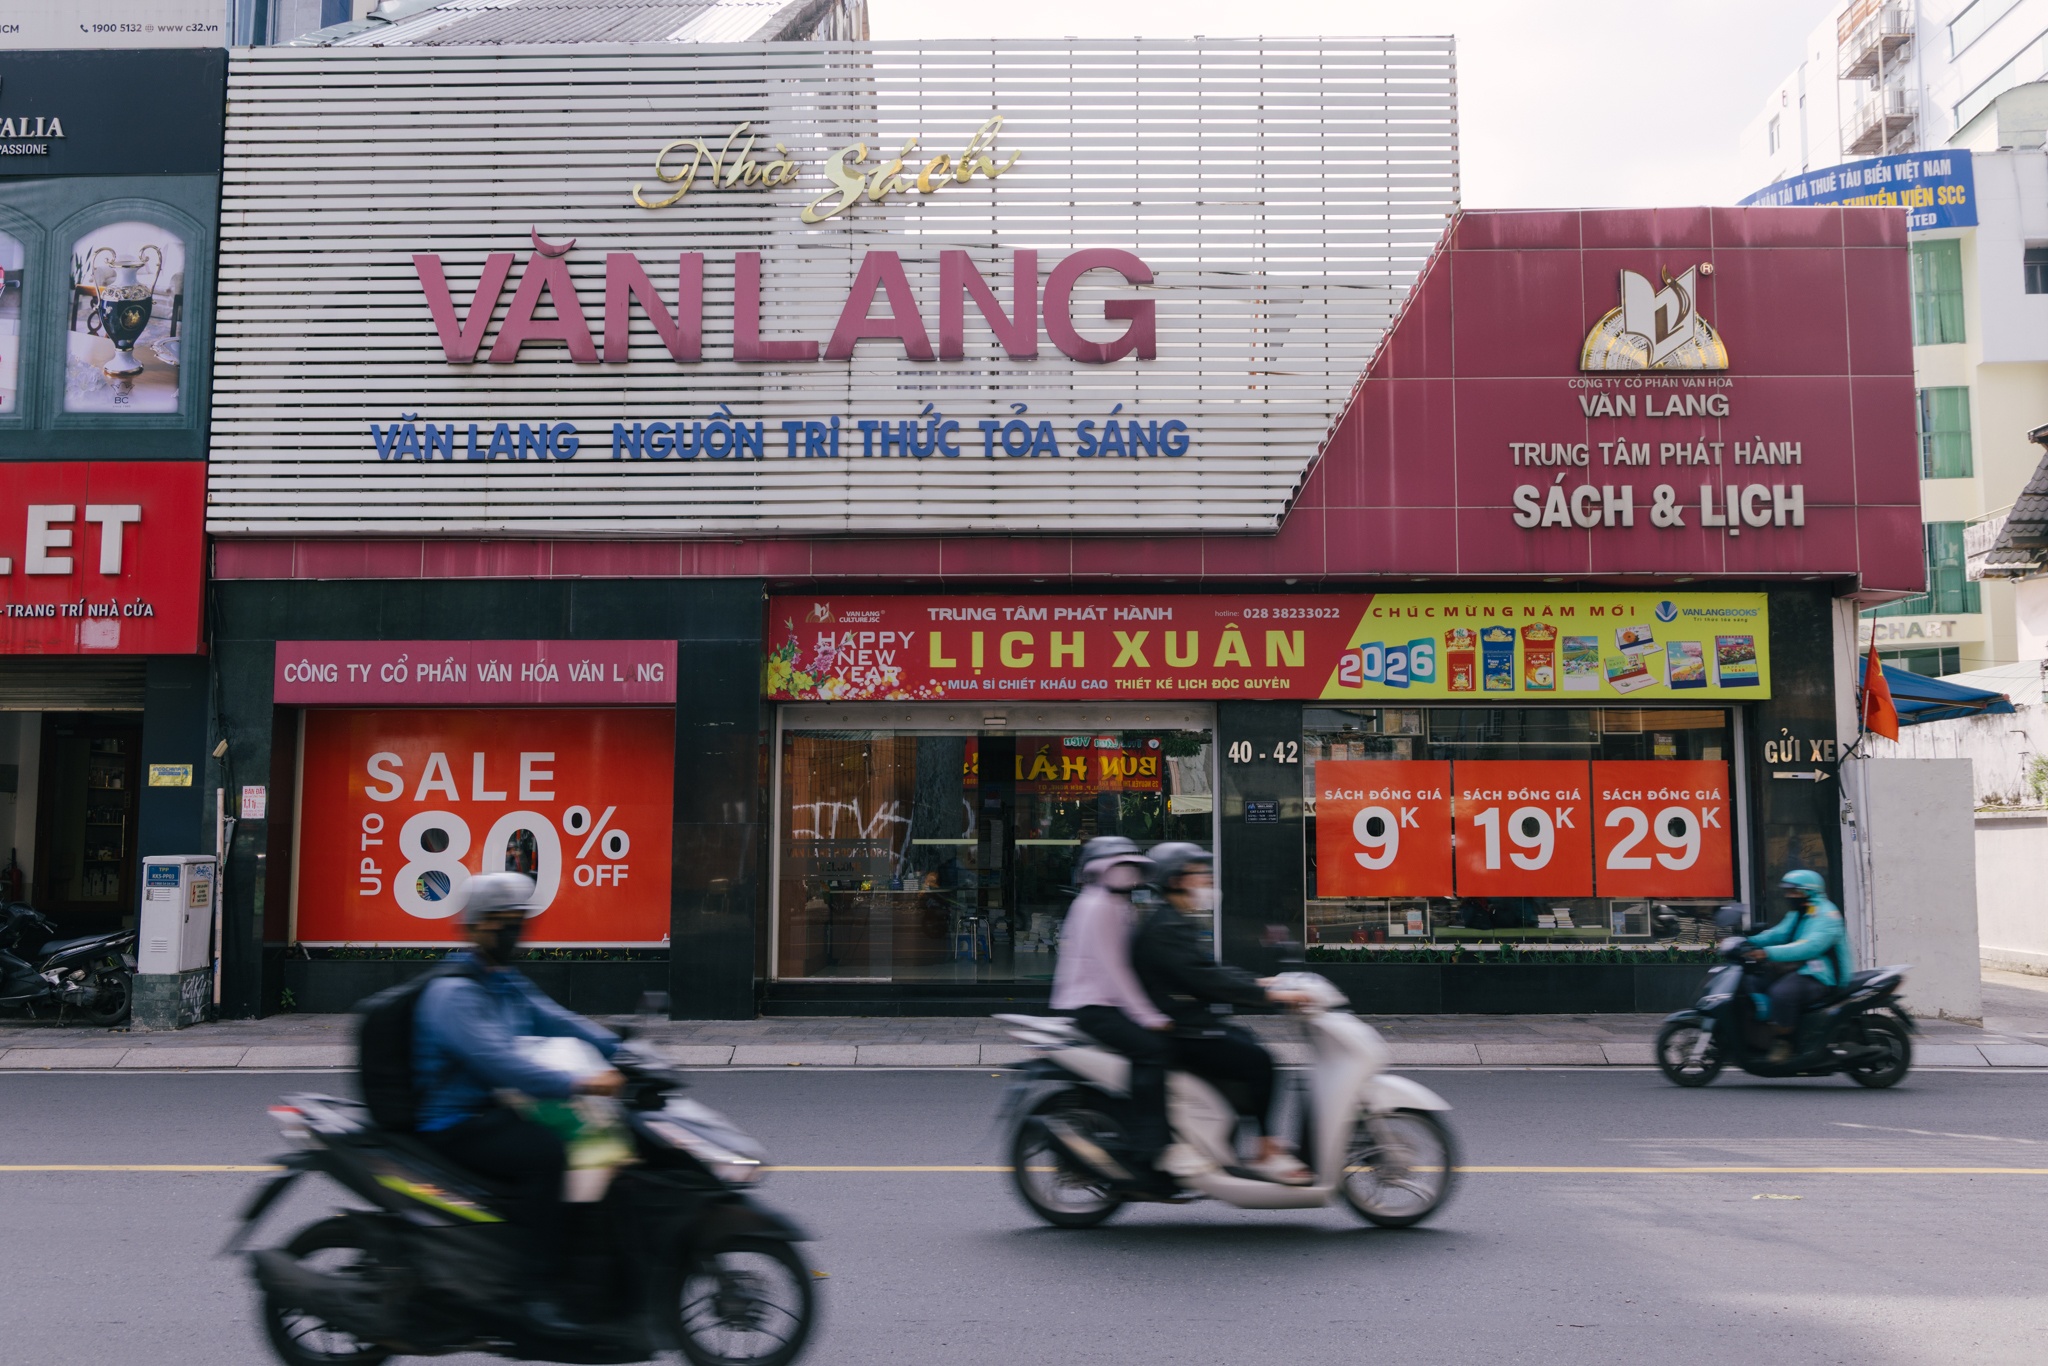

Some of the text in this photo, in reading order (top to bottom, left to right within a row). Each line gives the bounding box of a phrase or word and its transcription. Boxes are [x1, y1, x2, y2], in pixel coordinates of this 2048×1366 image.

[92, 23, 142, 33] 1900 5132
[0, 116, 65, 138] ALIA
[632, 115, 1022, 224] Nhà Sách
[1795, 180, 1808, 200] VÀ
[1809, 171, 1836, 197] THUÊ
[1839, 167, 1861, 189] TÀU
[1864, 160, 1891, 186] BIỂN
[1894, 159, 1920, 183] VIỆT
[1923, 159, 1951, 177] NAM
[1900, 184, 1935, 208] VIÊN
[1937, 185, 1966, 206] SCC
[1605, 378, 1621, 388] TY
[114, 396, 129, 404] BC
[1578, 391, 1730, 418] VĂN LANG
[370, 412, 455, 461] VĂN
[467, 422, 580, 460] LANG
[611, 403, 764, 459] NGUỒN
[858, 403, 961, 458] THỨC
[978, 403, 1060, 458] TỎA
[1076, 403, 1191, 458] SÁNG
[1509, 436, 1802, 467] TRUNG TÂM PHÁT HÀNH
[1512, 472, 1806, 536] SÁCH & LỊCH
[0, 504, 142, 575] ET
[6, 597, 154, 618] TRANG TRÍ NHÀ CỬA
[927, 604, 1173, 621] TRUNG TÂM PHÁT HÀNH
[1214, 607, 1340, 619] hotline: 028 38233022
[1372, 603, 1635, 618] CHÚC MỪNG NĂM MỚI
[1681, 608, 1758, 617] VANLANGBOOKS
[817, 631, 915, 650] HAPPY
[929, 622, 1305, 675] LỊCH XUÂN
[283, 659, 338, 684] CÔNG
[346, 662, 372, 683] TY
[380, 653, 409, 684] CỔ
[417, 656, 467, 683] PHẦN
[477, 658, 513, 683] VĂN
[521, 658, 559, 683] HÓA
[568, 658, 604, 683] VĂN
[837, 649, 896, 666] NEW
[1340, 643, 1434, 684] 2026
[834, 666, 899, 683] YEAR
[947, 679, 979, 690] MUA
[998, 676, 1036, 690] CHIẾT
[1040, 676, 1077, 690] KHẤU
[1081, 679, 1108, 690] CAO
[1114, 676, 1152, 690] THIẾT
[1156, 676, 1173, 690] KẾ
[1177, 678, 1208, 691] LỊCH
[1211, 676, 1240, 691] ĐỘC
[1228, 740, 1253, 764] 40
[1273, 740, 1299, 764] 42
[1764, 727, 1836, 764] GỬI XE
[364, 751, 556, 802] SALE
[1324, 788, 1363, 801] SÁCH
[1416, 788, 1442, 801] GIÁ
[1463, 788, 1502, 801] SÁCH
[1555, 788, 1582, 801] GIÁ
[1602, 788, 1642, 801] SÁCH
[1695, 788, 1722, 801] GIÁ
[359, 812, 385, 896] UP TO
[573, 864, 630, 887] OFF
